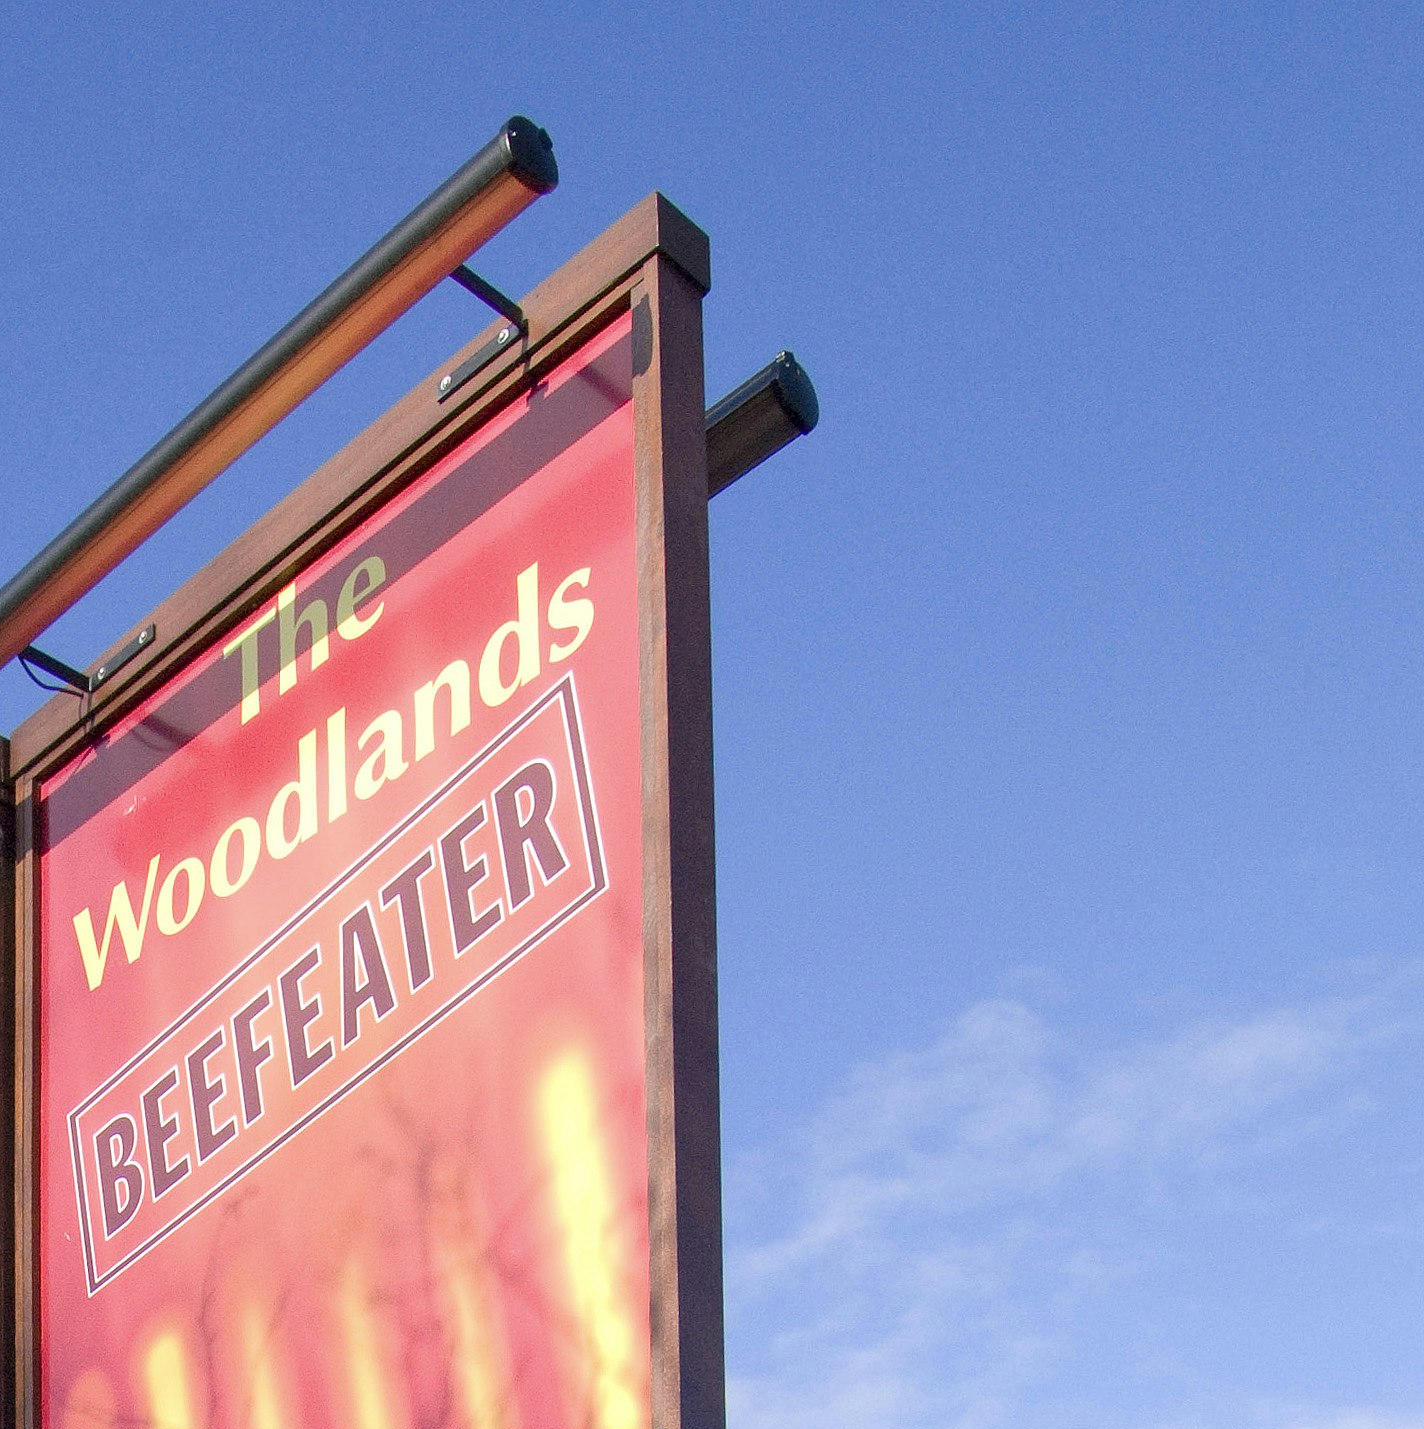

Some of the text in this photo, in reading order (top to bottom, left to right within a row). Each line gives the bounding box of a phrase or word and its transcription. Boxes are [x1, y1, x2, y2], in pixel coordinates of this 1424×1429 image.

[72, 561, 595, 992] Woodlands
[223, 555, 387, 725] The
[94, 757, 571, 1242] BEEFEATER
